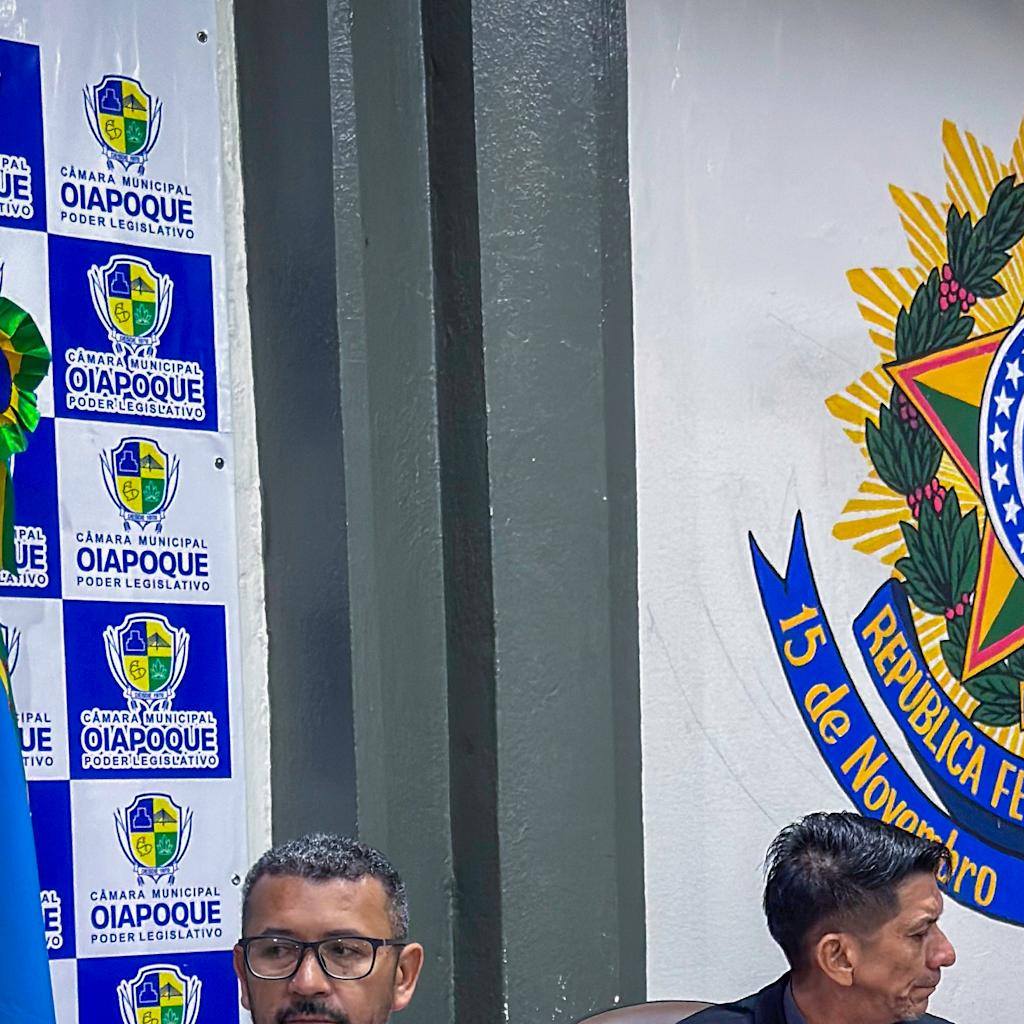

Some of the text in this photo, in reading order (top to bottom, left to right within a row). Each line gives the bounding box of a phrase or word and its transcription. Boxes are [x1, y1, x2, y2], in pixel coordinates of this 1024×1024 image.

[60, 165, 192, 196] CÂMARA MUNICIPAL
[61, 182, 193, 225] OIAPOQUE
[61, 211, 194, 239] PODER LEGISLATIVO
[68, 350, 201, 375] CÂMARA MUNICIPAL
[69, 367, 202, 403] OIAPOQUE
[69, 396, 203, 418] PODER LEGISLATIVO
[76, 530, 208, 549] CÂMARA MUNICIPAL
[76, 547, 209, 578] OIAPOQUE
[77, 576, 210, 591] PODER LEGISLATIVO
[779, 603, 827, 667] 15
[804, 683, 850, 745] de
[83, 711, 215, 724] CÂMARA MUNICIPAL
[84, 727, 216, 754] OIAPOQUE
[84, 755, 217, 766] PODER LEGISLATIVO
[90, 887, 221, 901] CÂMARA MUNICIPAL
[91, 900, 221, 929] OIAPOQUE
[91, 928, 222, 944] PODER LEGISLATIVO
